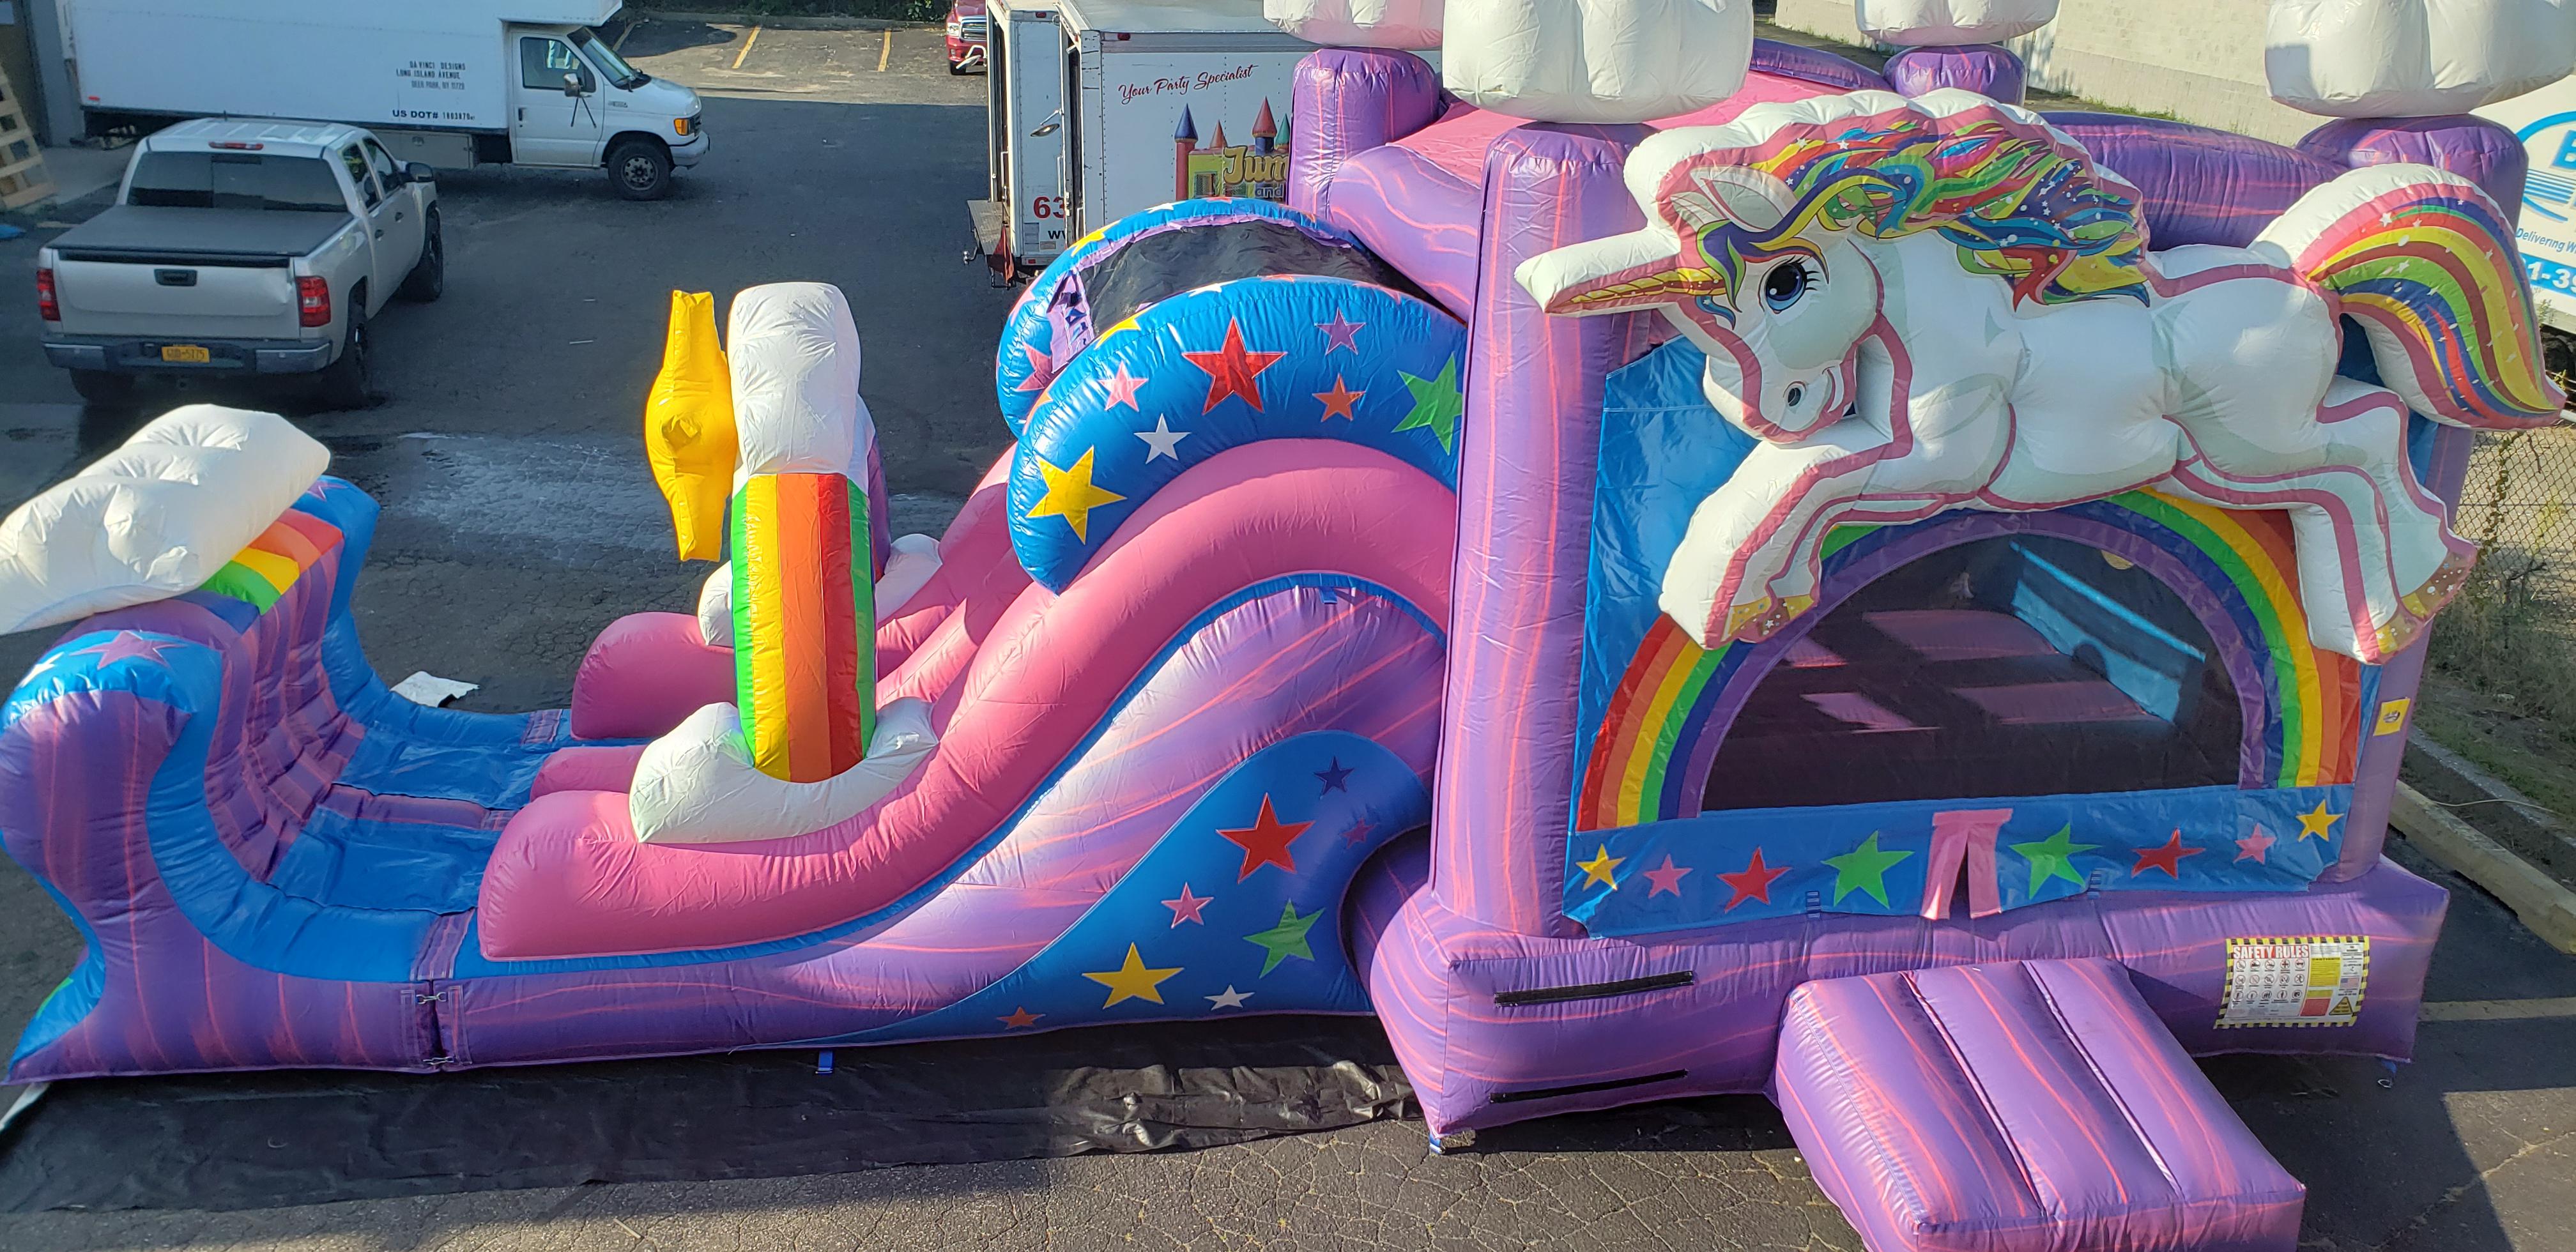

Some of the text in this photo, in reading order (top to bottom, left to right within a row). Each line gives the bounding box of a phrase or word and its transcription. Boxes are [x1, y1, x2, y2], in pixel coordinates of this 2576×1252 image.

[440, 62, 466, 70] DESIGNS
[413, 70, 435, 78] ISLAND
[438, 71, 460, 79] AVENUE
[1118, 65, 1259, 105] Your Party Specialist
[392, 109, 407, 118] US
[410, 111, 438, 119] DOT#
[1255, 182, 1284, 198] and
[2515, 228, 2565, 252] Delivering
[2234, 945, 2273, 959] SAFETY
[2274, 945, 2309, 958] RULES
